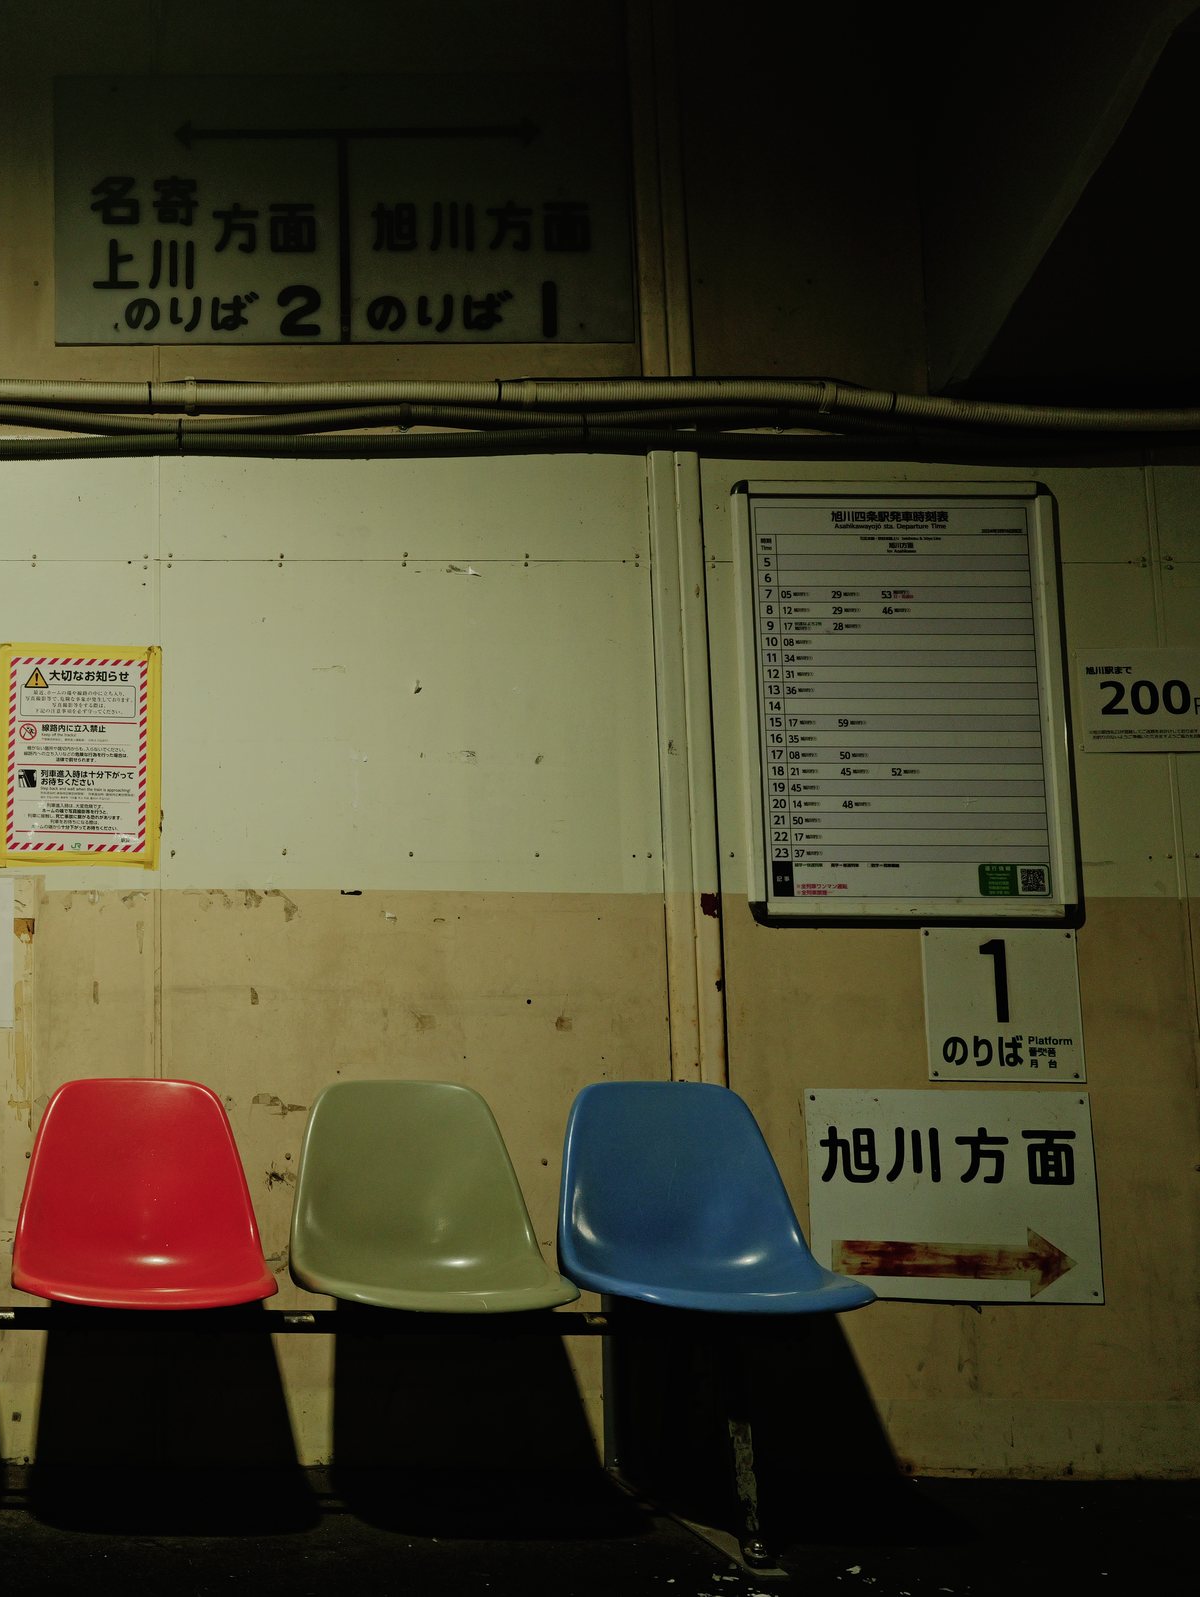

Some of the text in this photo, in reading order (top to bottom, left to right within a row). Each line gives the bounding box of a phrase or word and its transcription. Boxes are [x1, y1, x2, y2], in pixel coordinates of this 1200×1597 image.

[90, 176, 198, 225] 名寄
[214, 204, 316, 252] 方面
[372, 202, 590, 252] 旭川方面
[92, 239, 195, 290] 上川
[125, 284, 321, 336] のりば 2
[368, 282, 557, 337] のりば 1
[832, 511, 948, 522] 旭川四条駅発車時刻表
[764, 558, 771, 567] 5
[765, 590, 892, 599] 7 05 29 53
[766, 605, 773, 614] 8
[882, 607, 893, 615] 46
[767, 669, 780, 679] 12
[1086, 666, 1132, 675] 旭川駅まで
[49, 670, 129, 682] 大切なお知らせ
[770, 718, 849, 727] 15 17 59
[42, 724, 106, 733] 線路内に立入禁止
[41, 770, 134, 779] 列車進入時は十分下がって
[772, 766, 902, 776] 18 21 45 52
[41, 778, 94, 786] お待ちください
[773, 799, 786, 809] 20
[842, 800, 853, 808] 48
[775, 848, 805, 858] 23 37
[979, 939, 1009, 1022] 1
[1028, 1036, 1072, 1045] Platform
[942, 1035, 1024, 1067] のりば
[820, 1125, 1076, 1186] 旭川方面
